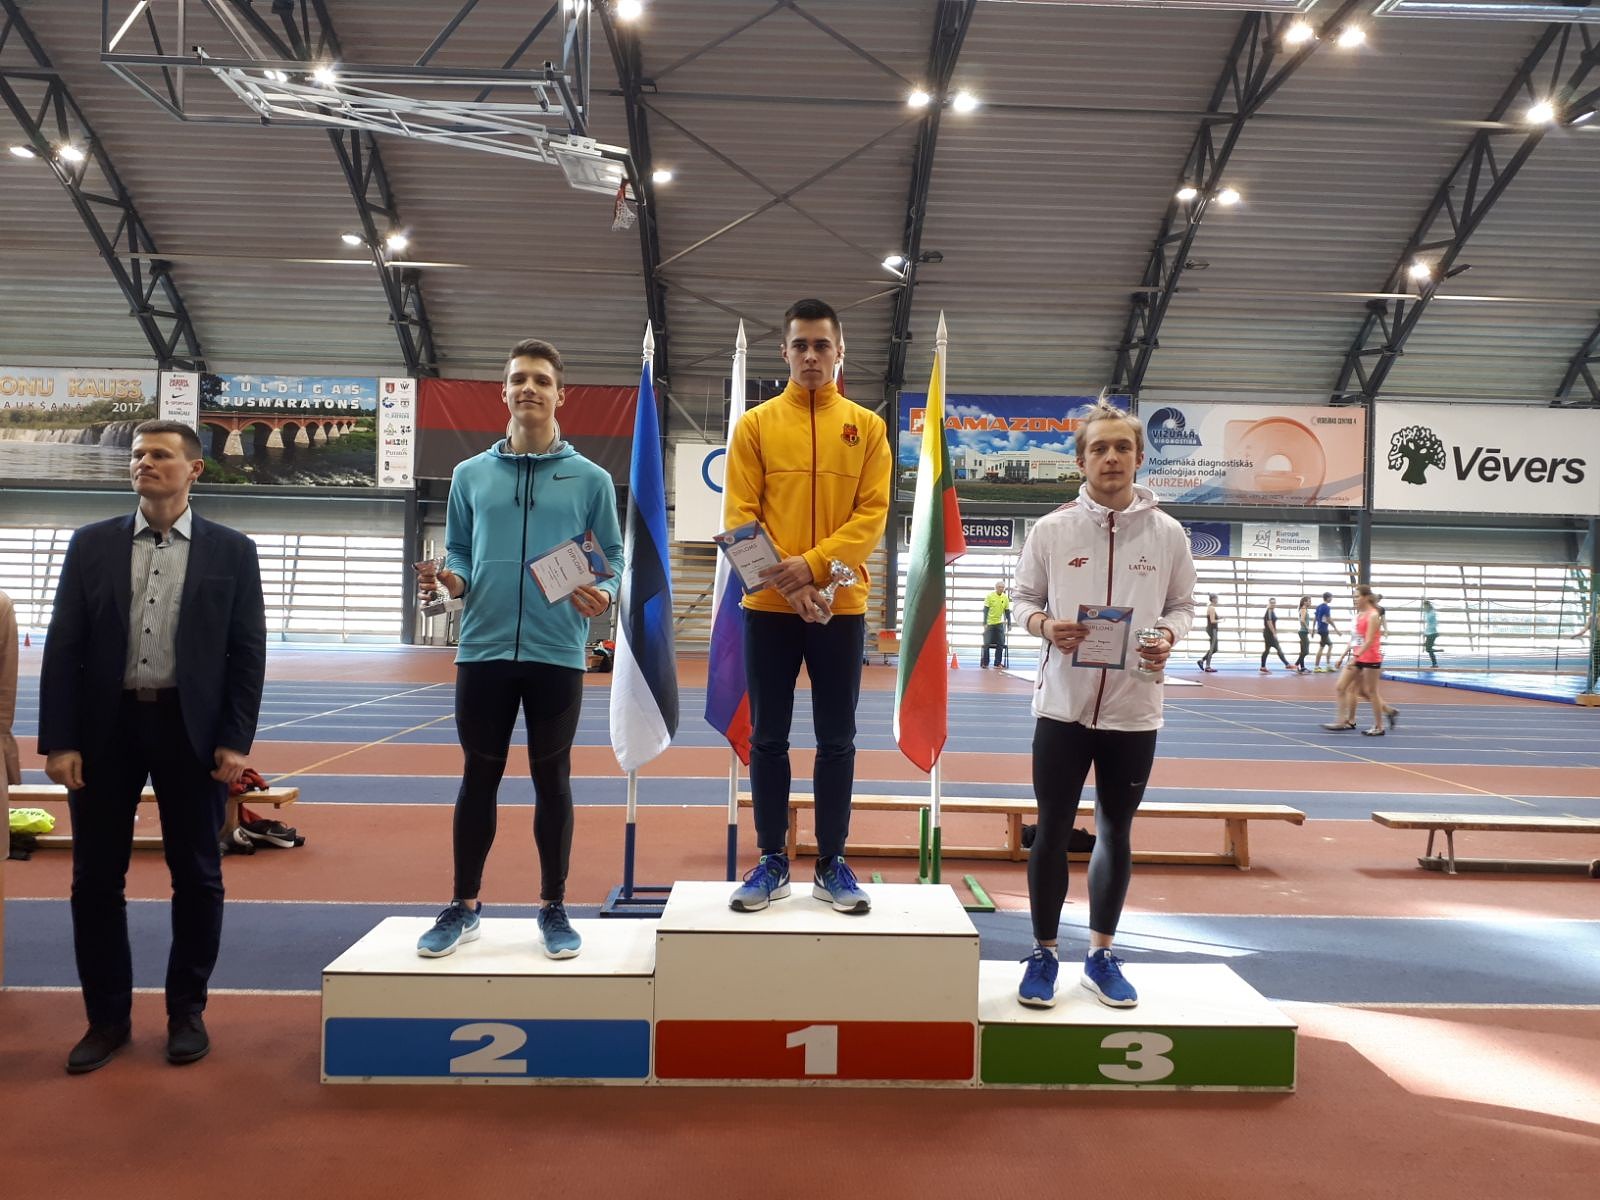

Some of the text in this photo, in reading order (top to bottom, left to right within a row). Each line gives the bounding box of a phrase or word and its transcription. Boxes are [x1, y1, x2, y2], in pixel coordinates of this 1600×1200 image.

[68, 376, 143, 399] KAUSS
[112, 402, 140, 413] 2017
[220, 397, 359, 409] PUSMARATONS
[1453, 446, 1586, 484] Vēvers
[963, 524, 1009, 537] SERVISS
[1129, 564, 1156, 572] LATVIJA
[1087, 623, 1114, 631] IPLOMS
[450, 1022, 527, 1073] 2
[786, 1024, 838, 1075] 1
[1098, 1031, 1174, 1082] 3
